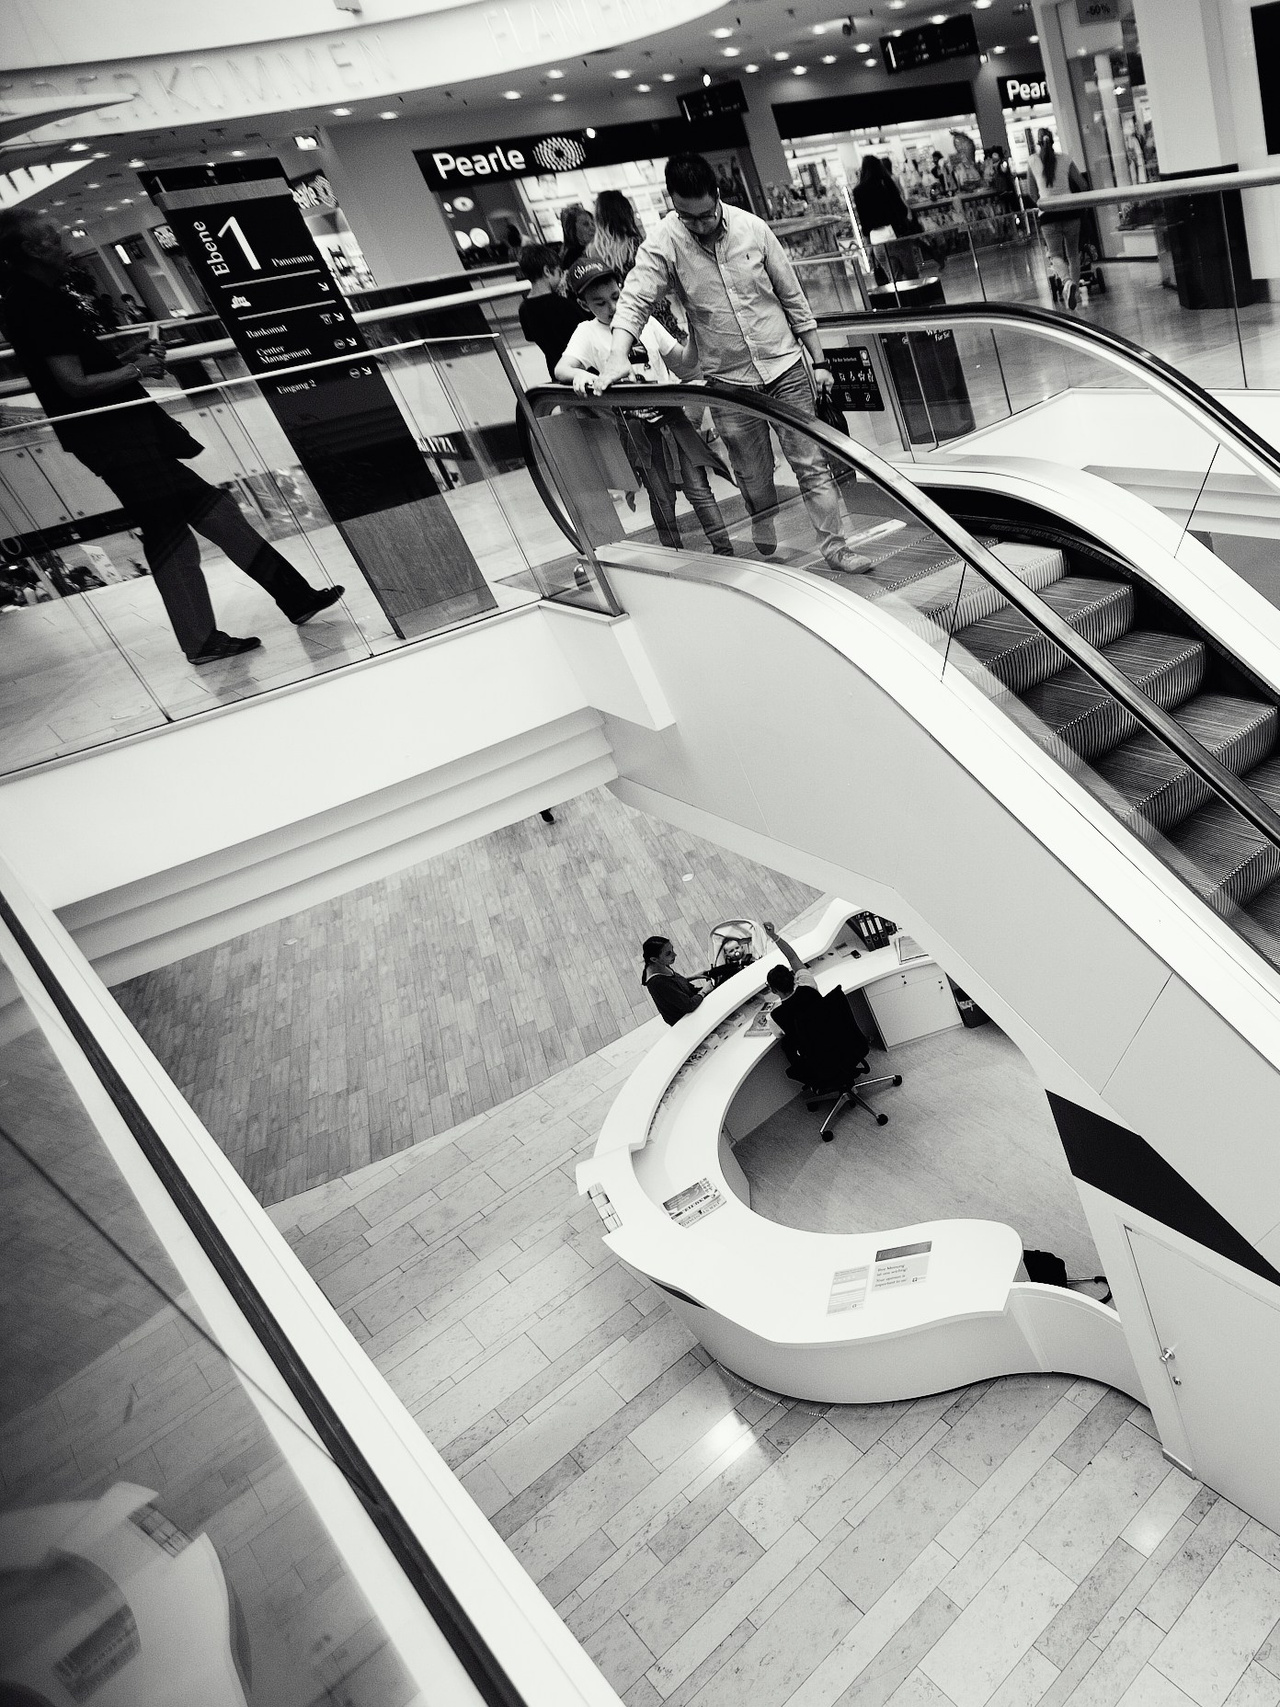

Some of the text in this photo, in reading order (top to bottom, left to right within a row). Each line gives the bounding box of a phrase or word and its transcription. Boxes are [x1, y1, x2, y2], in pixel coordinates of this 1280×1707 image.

[1006, 80, 1047, 102] Pear
[432, 145, 527, 180] Pearle
[193, 220, 231, 277] Ebene
[217, 215, 262, 271] 1
[271, 254, 315, 268] Panorama
[245, 324, 288, 339] Bankomat
[256, 345, 285, 357] Center
[260, 348, 312, 364] Management
[276, 381, 310, 395] Eingang
